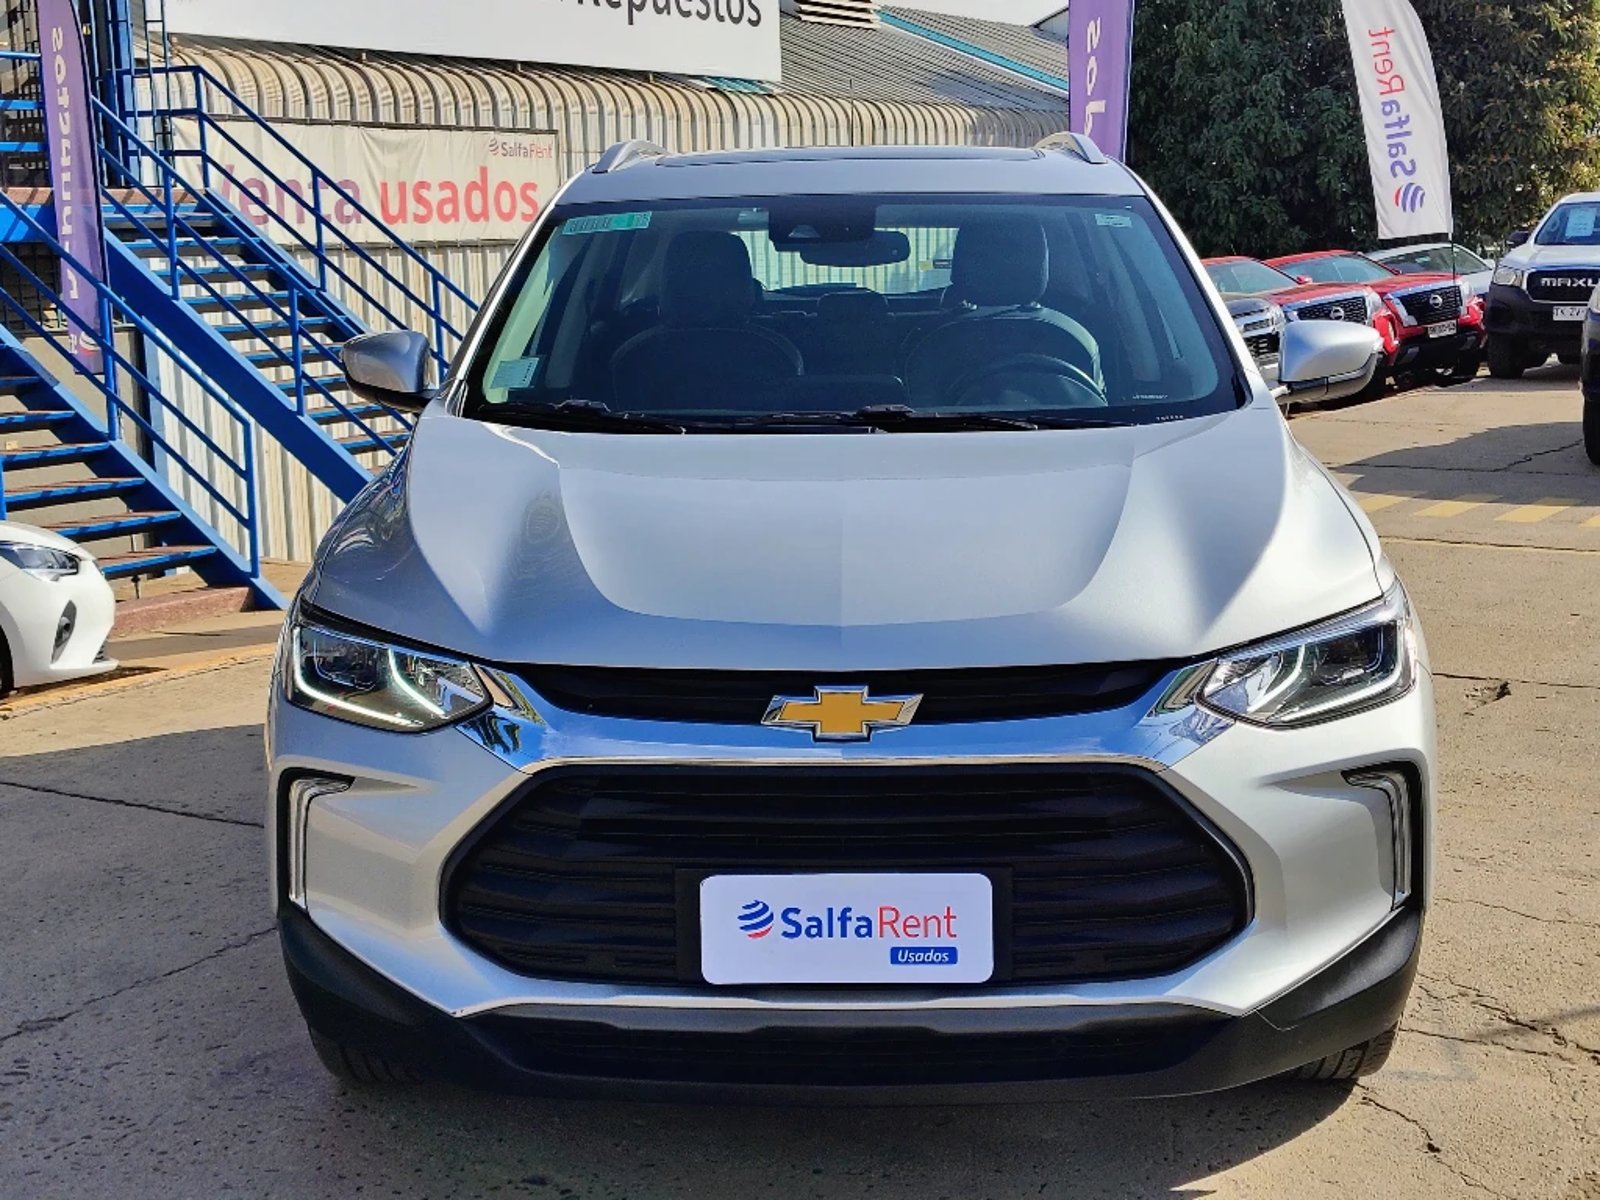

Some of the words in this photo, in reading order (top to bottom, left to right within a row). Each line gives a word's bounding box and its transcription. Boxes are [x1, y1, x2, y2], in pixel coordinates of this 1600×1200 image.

[577, 0, 762, 27] puestos
[379, 165, 539, 225] usados
[780, 905, 958, 940] SalfaRent
[897, 949, 950, 963] Usados
